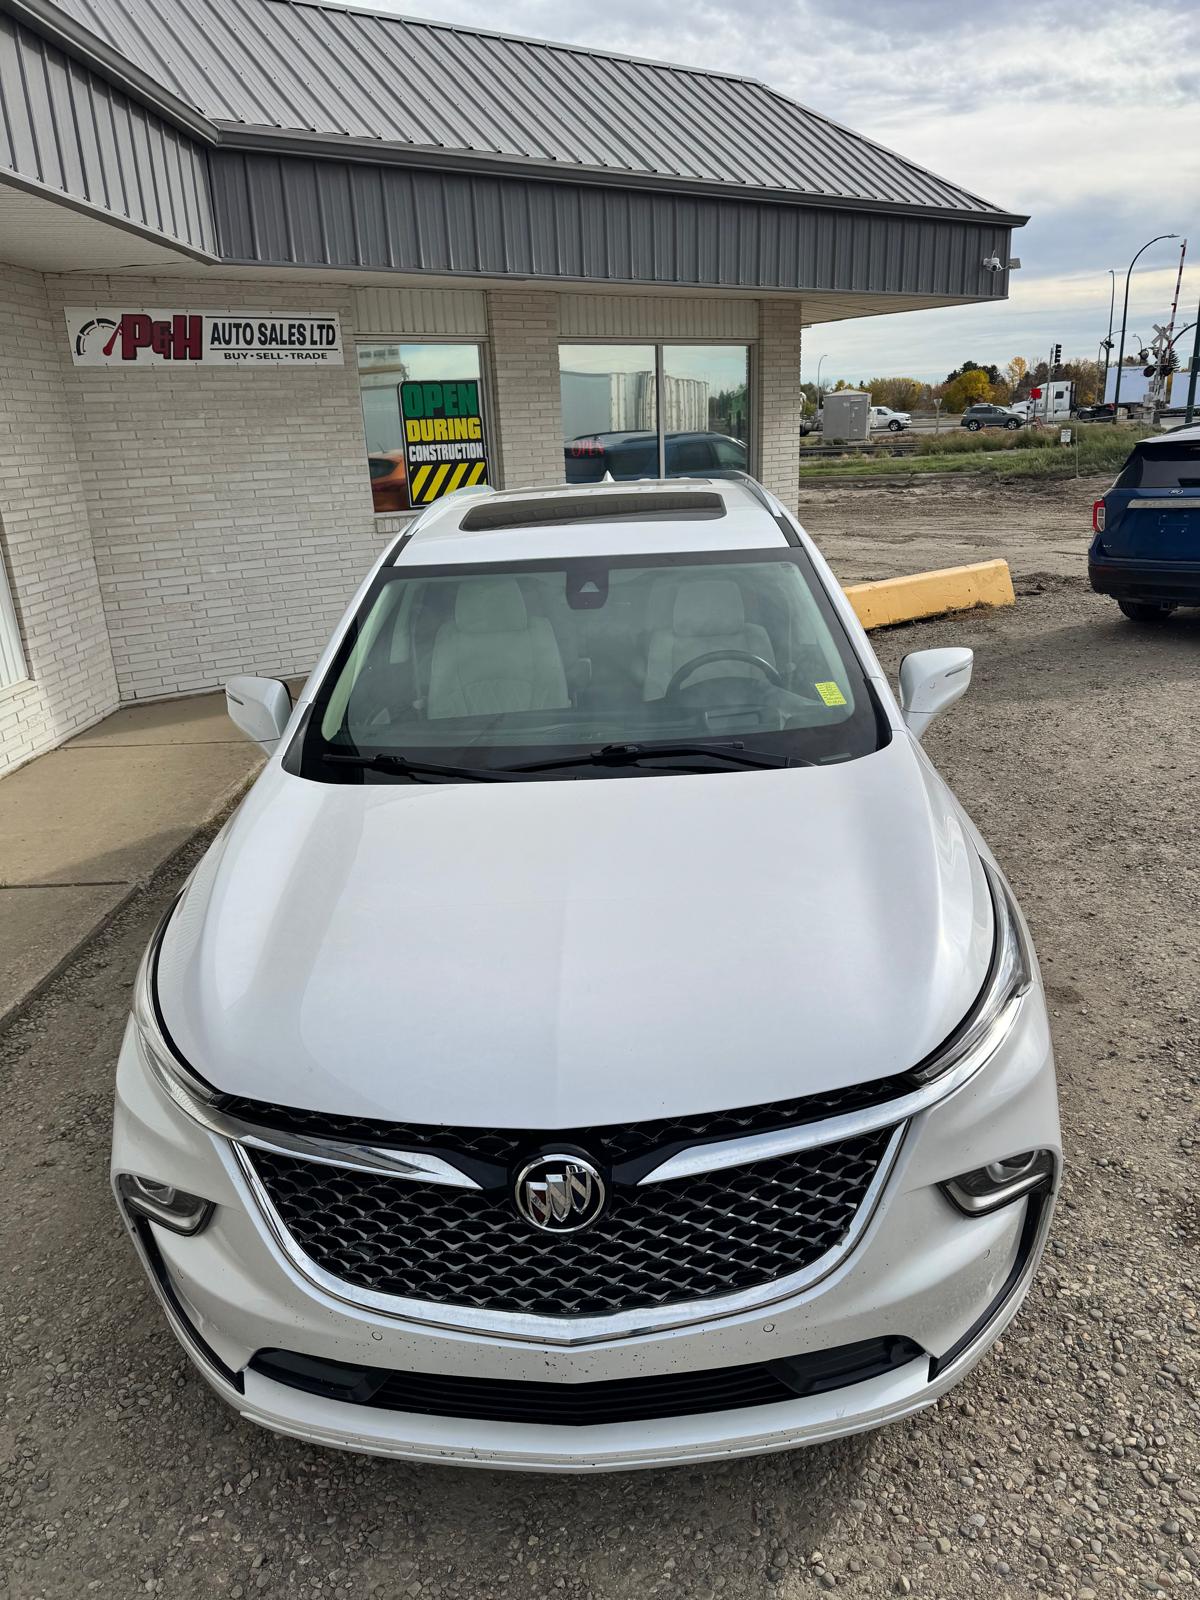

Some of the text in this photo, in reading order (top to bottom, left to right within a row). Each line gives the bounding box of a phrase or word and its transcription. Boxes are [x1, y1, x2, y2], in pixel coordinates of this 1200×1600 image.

[121, 314, 203, 360] P&H
[210, 322, 336, 346] AUTO SALES LTD
[401, 382, 478, 418] OPEN
[405, 417, 482, 443] DURING
[408, 442, 484, 463] CONSTRUCTION
